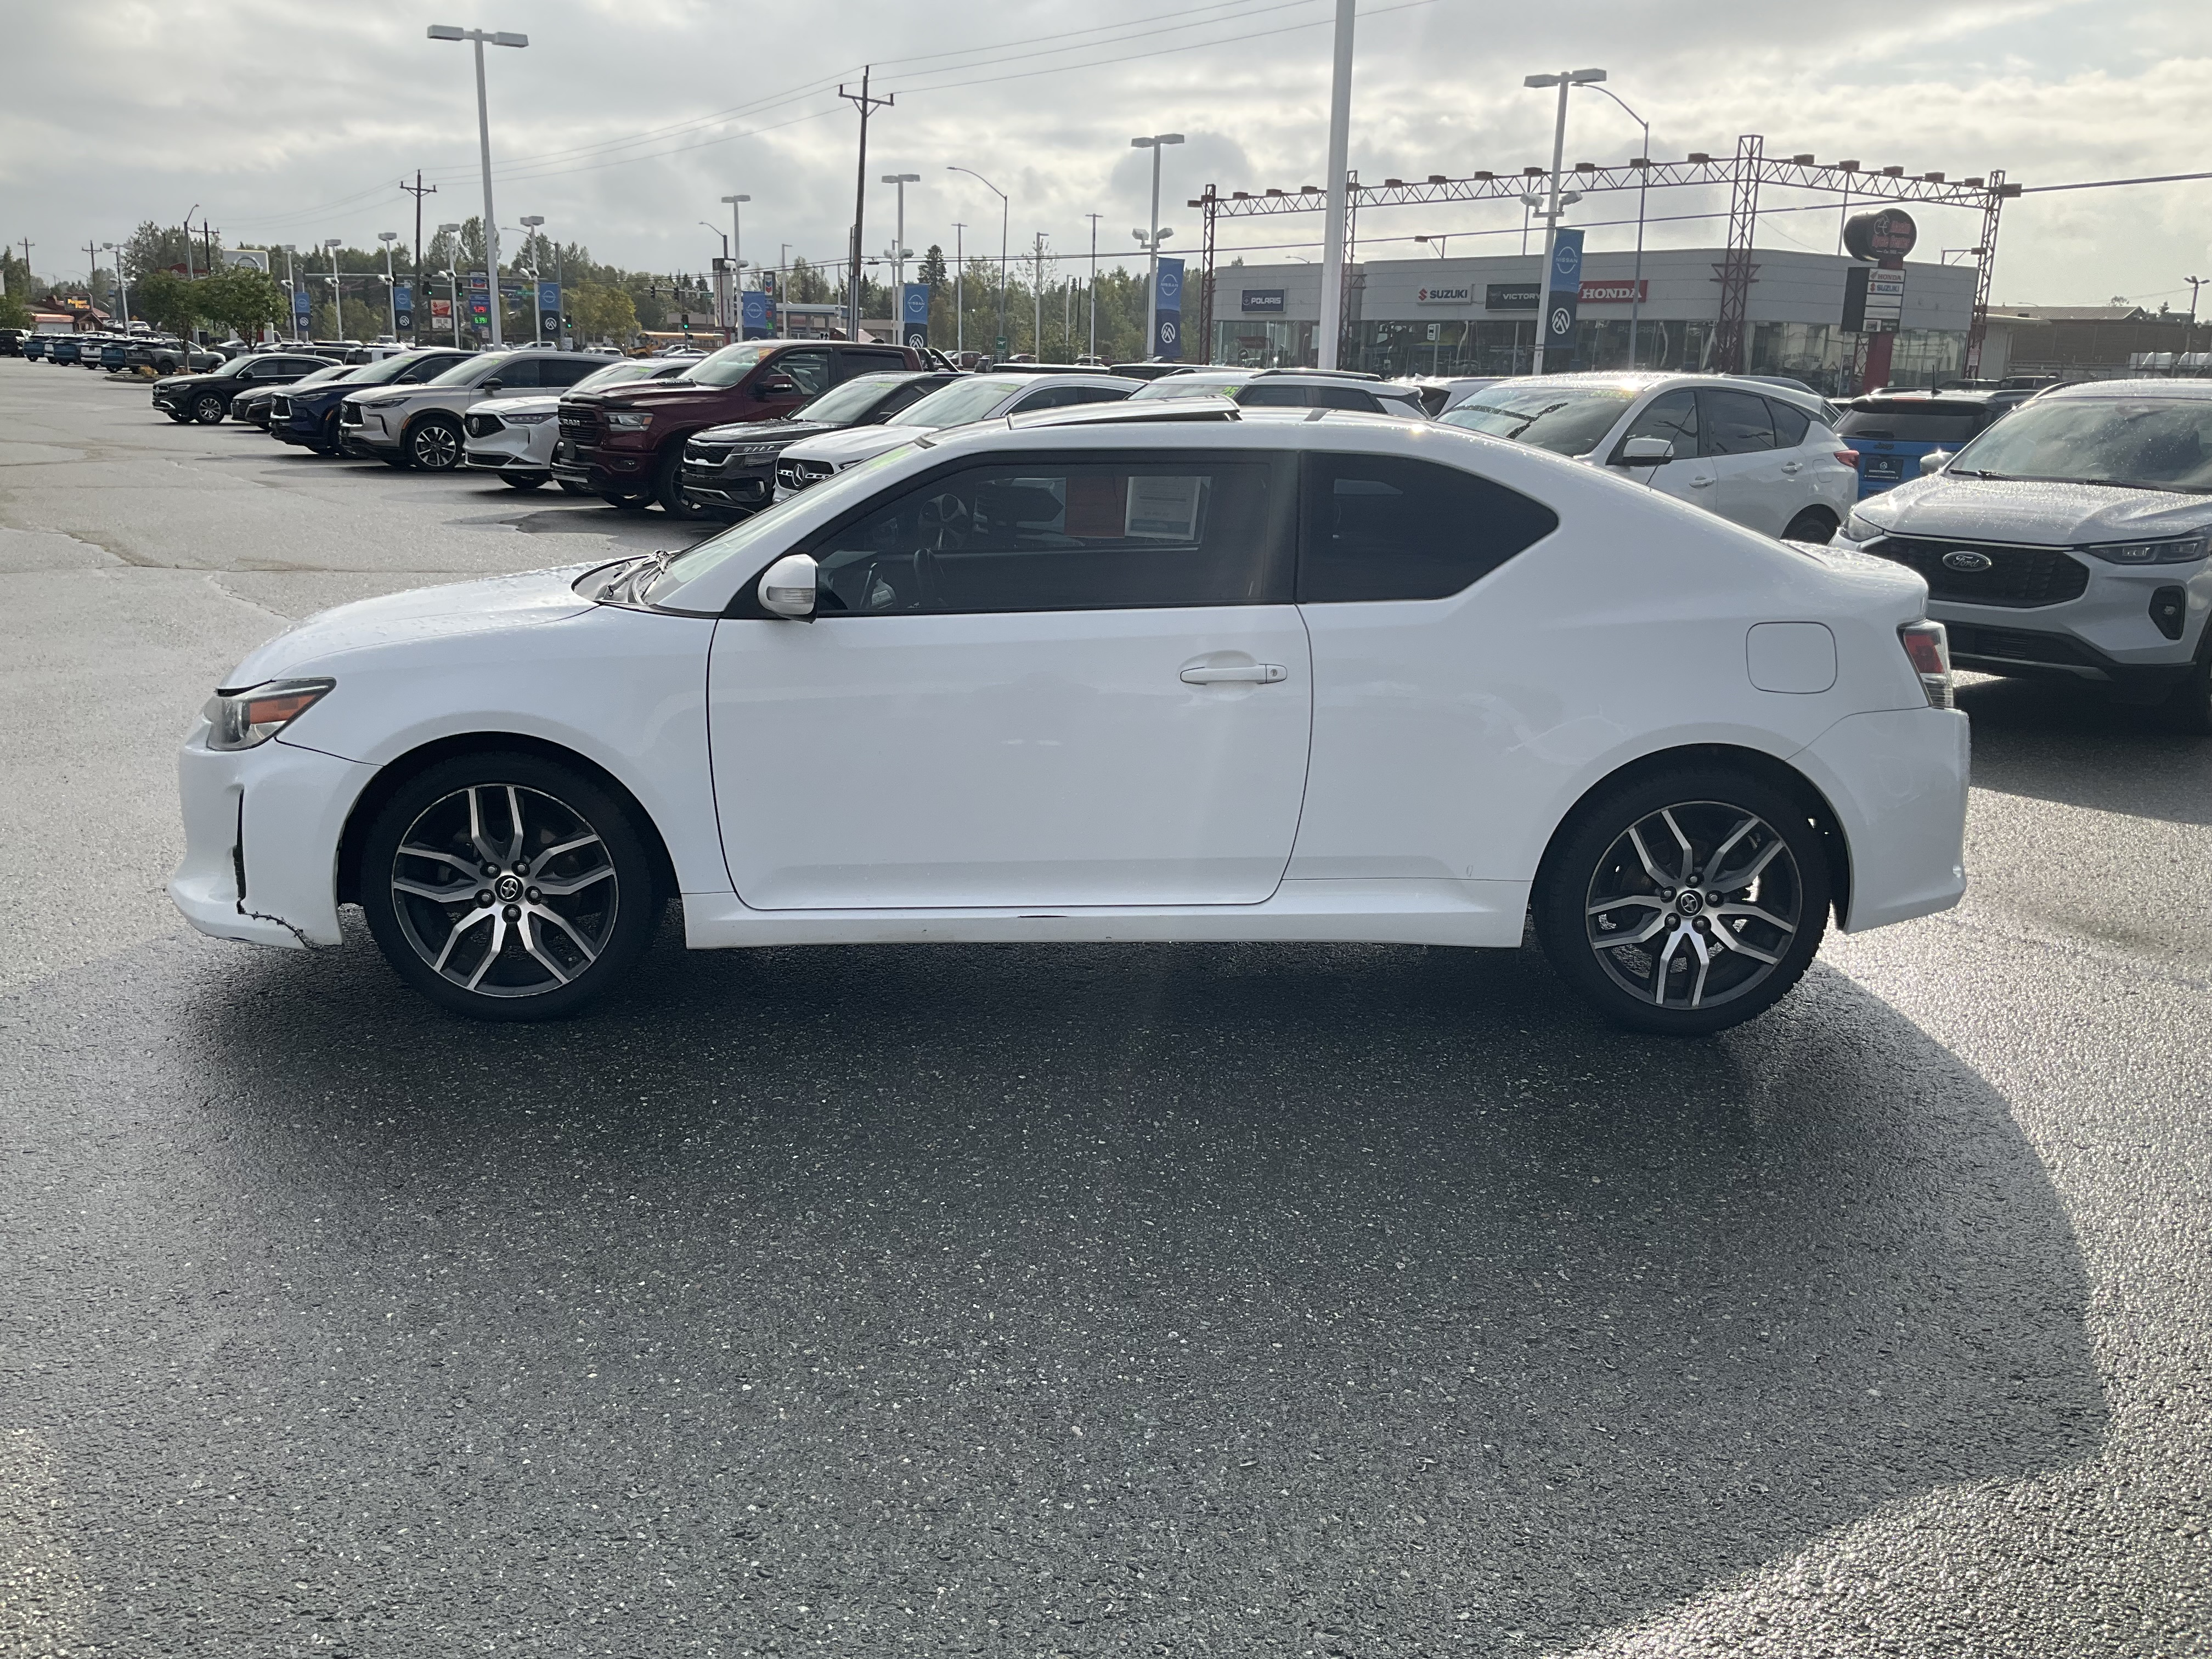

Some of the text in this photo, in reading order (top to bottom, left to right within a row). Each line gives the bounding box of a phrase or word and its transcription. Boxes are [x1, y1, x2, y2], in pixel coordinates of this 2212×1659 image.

[1430, 290, 1468, 299] SUZUKI
[1582, 288, 1642, 299] HONDA
[1220, 386, 1239, 398] 25
[1953, 555, 1979, 568] Ford
